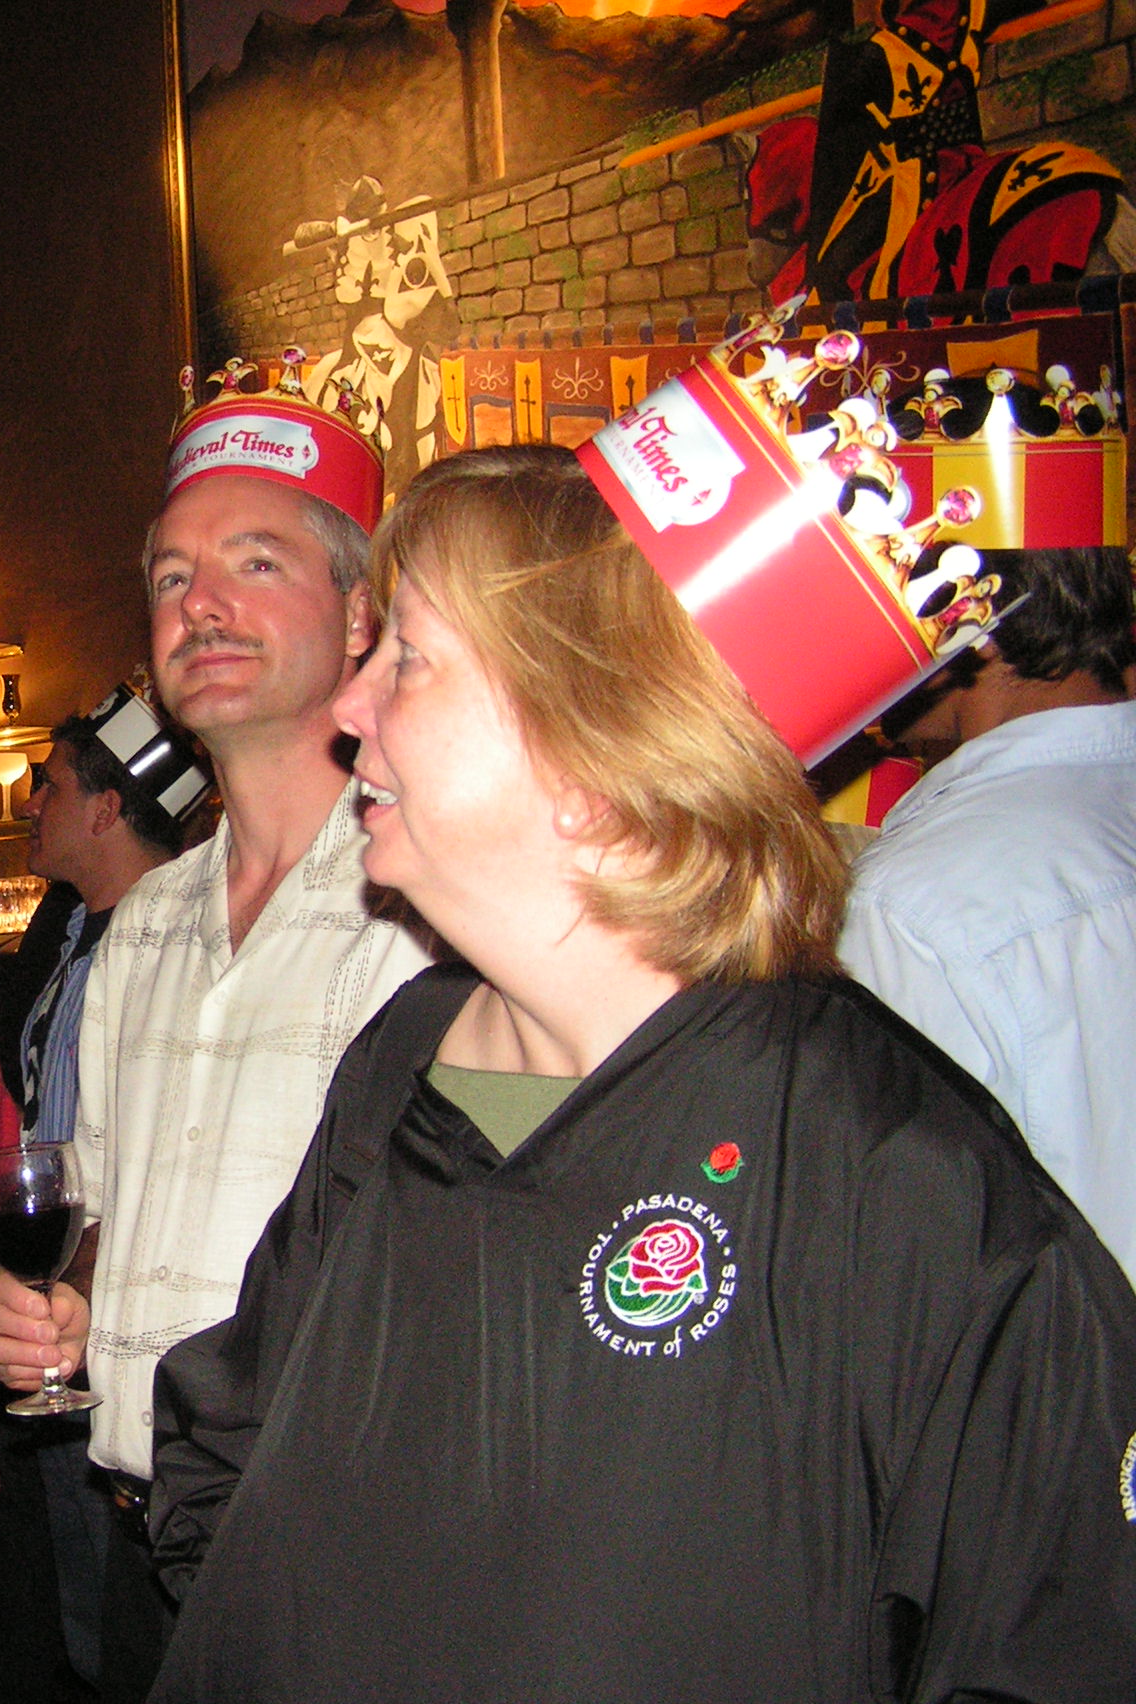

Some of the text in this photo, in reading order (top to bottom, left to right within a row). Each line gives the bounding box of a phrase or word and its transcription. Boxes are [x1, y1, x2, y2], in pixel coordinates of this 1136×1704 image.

[203, 451, 294, 468] TOURNAMENT
[231, 430, 295, 459] Times
[633, 416, 689, 493] Times
[621, 1193, 728, 1244] PASADENA
[579, 1232, 737, 1358] TOURNAMENT of ROSES
